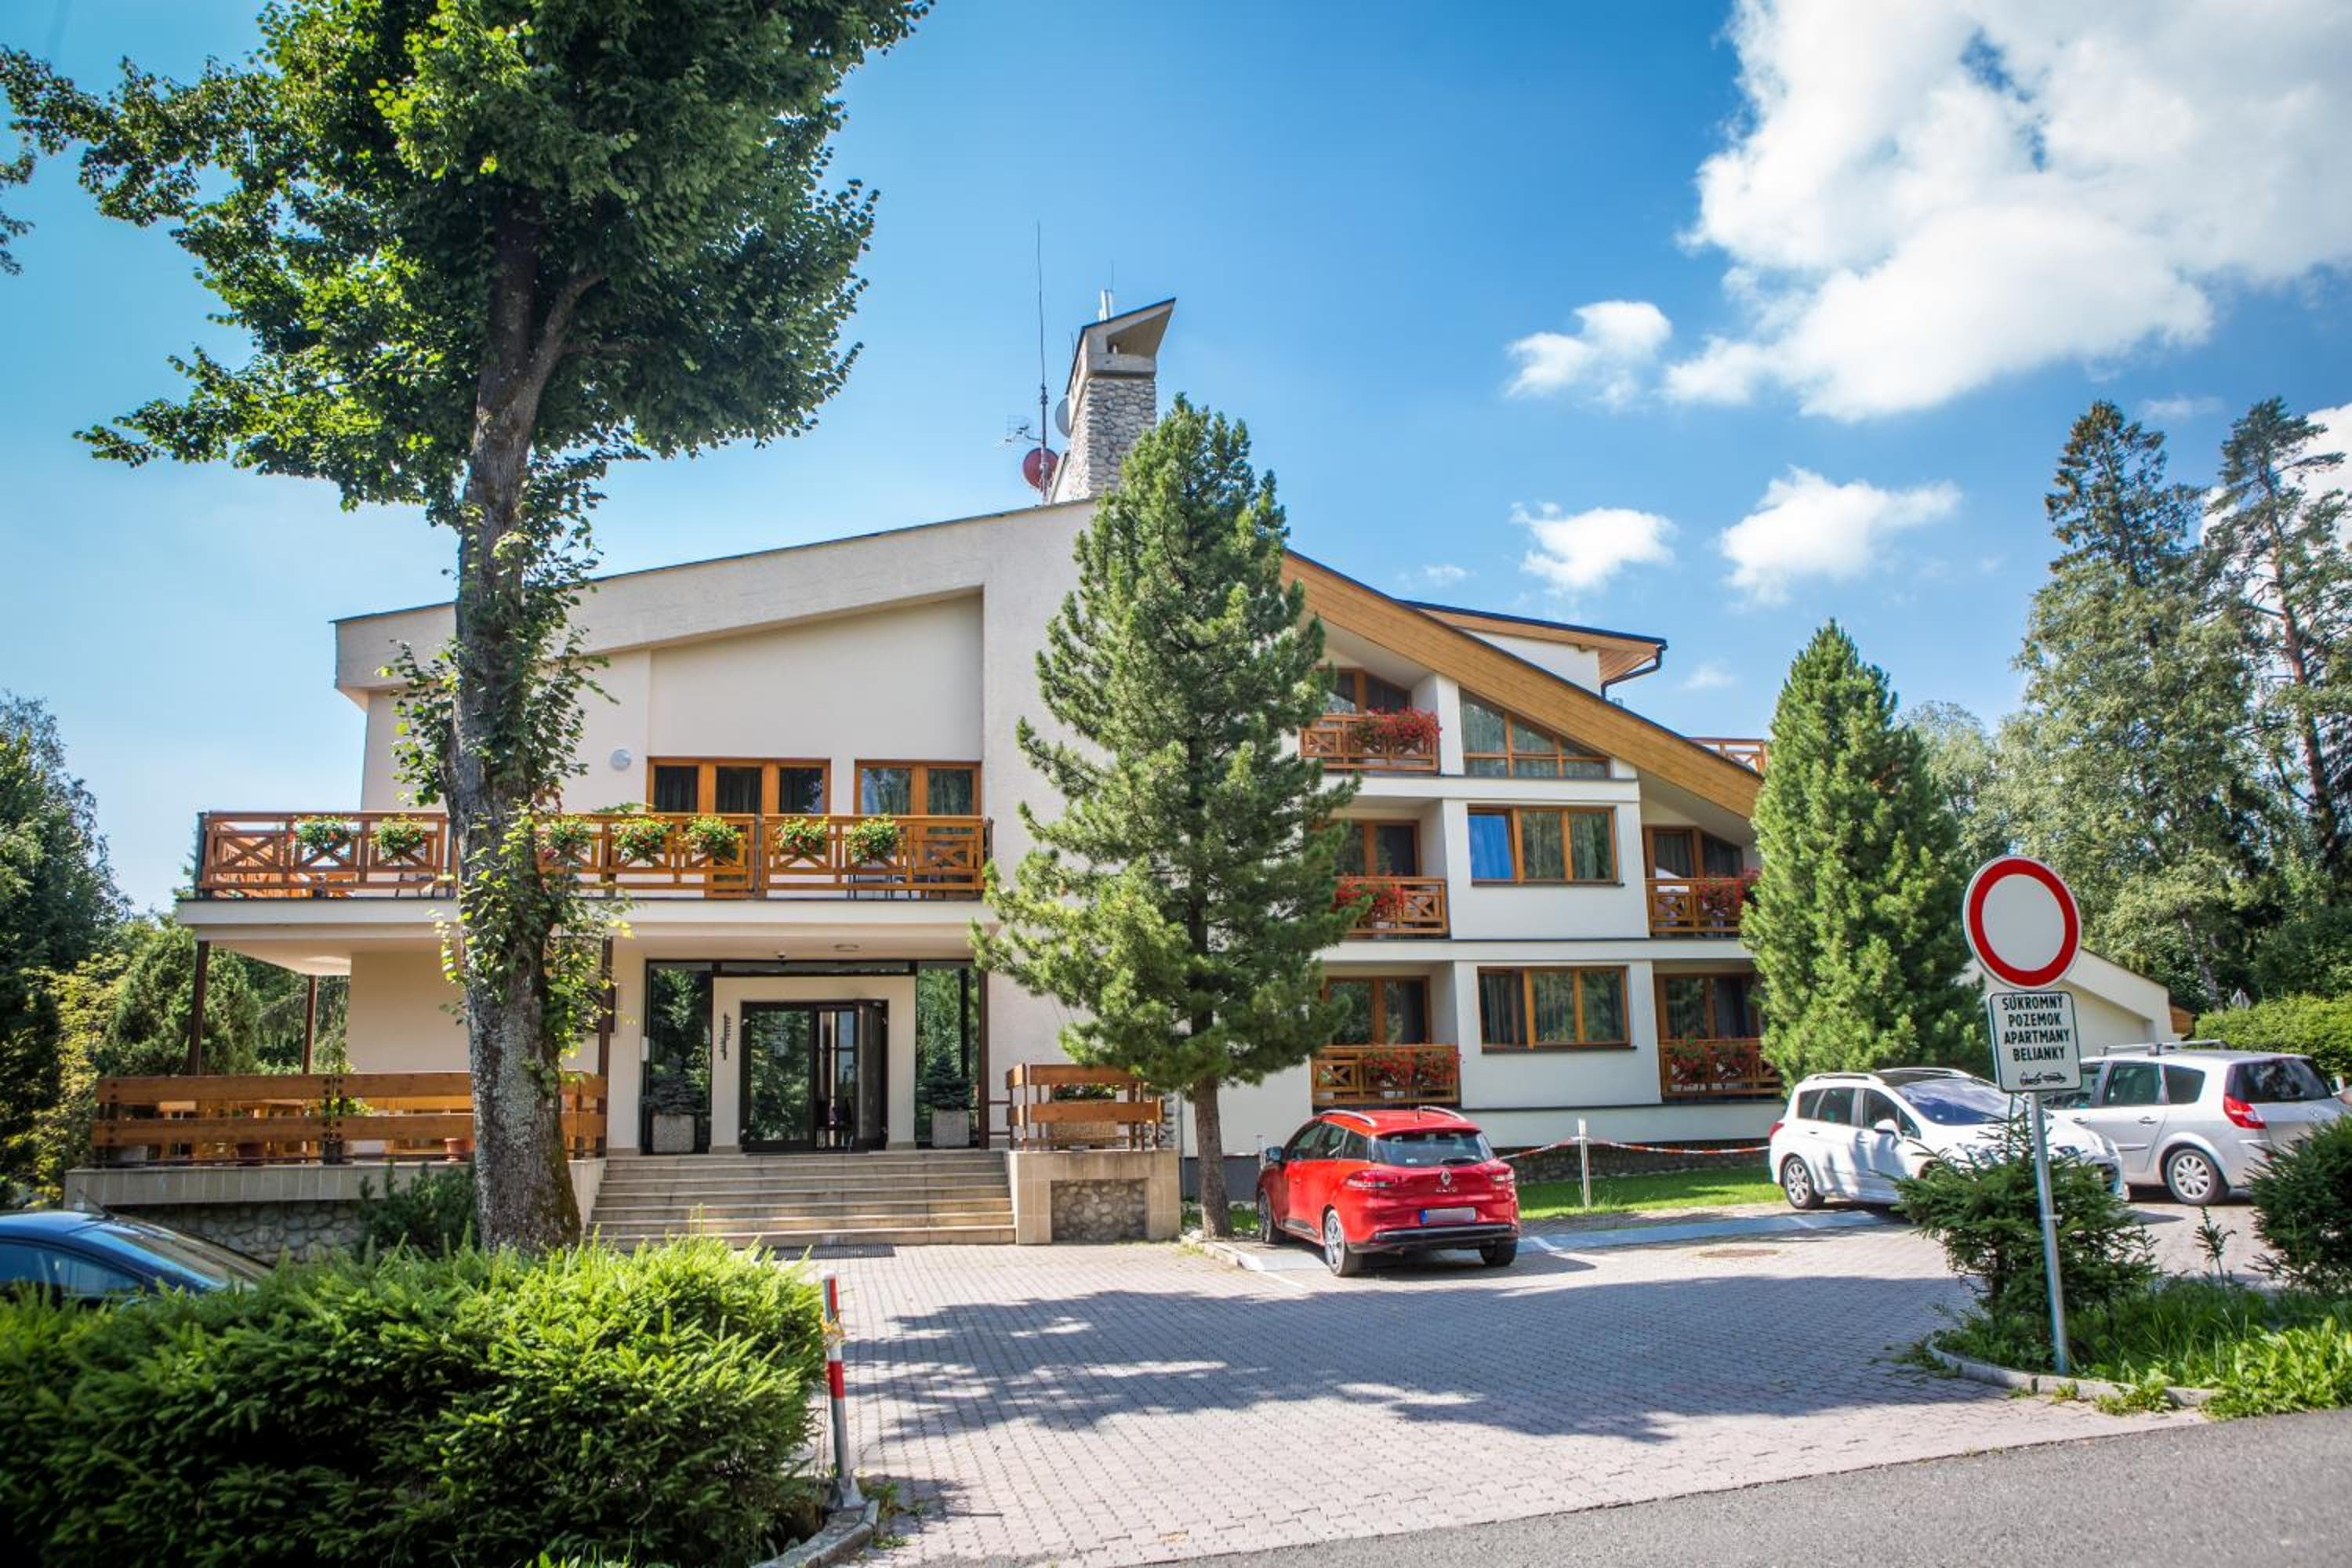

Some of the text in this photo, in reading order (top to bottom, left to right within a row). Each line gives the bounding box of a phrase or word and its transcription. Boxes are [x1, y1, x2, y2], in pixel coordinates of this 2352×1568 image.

[2008, 1012, 2062, 1028] POZEMOK
[2004, 1029, 2070, 1045] APARTMANY
[2013, 1045, 2065, 1062] BELIANKY
